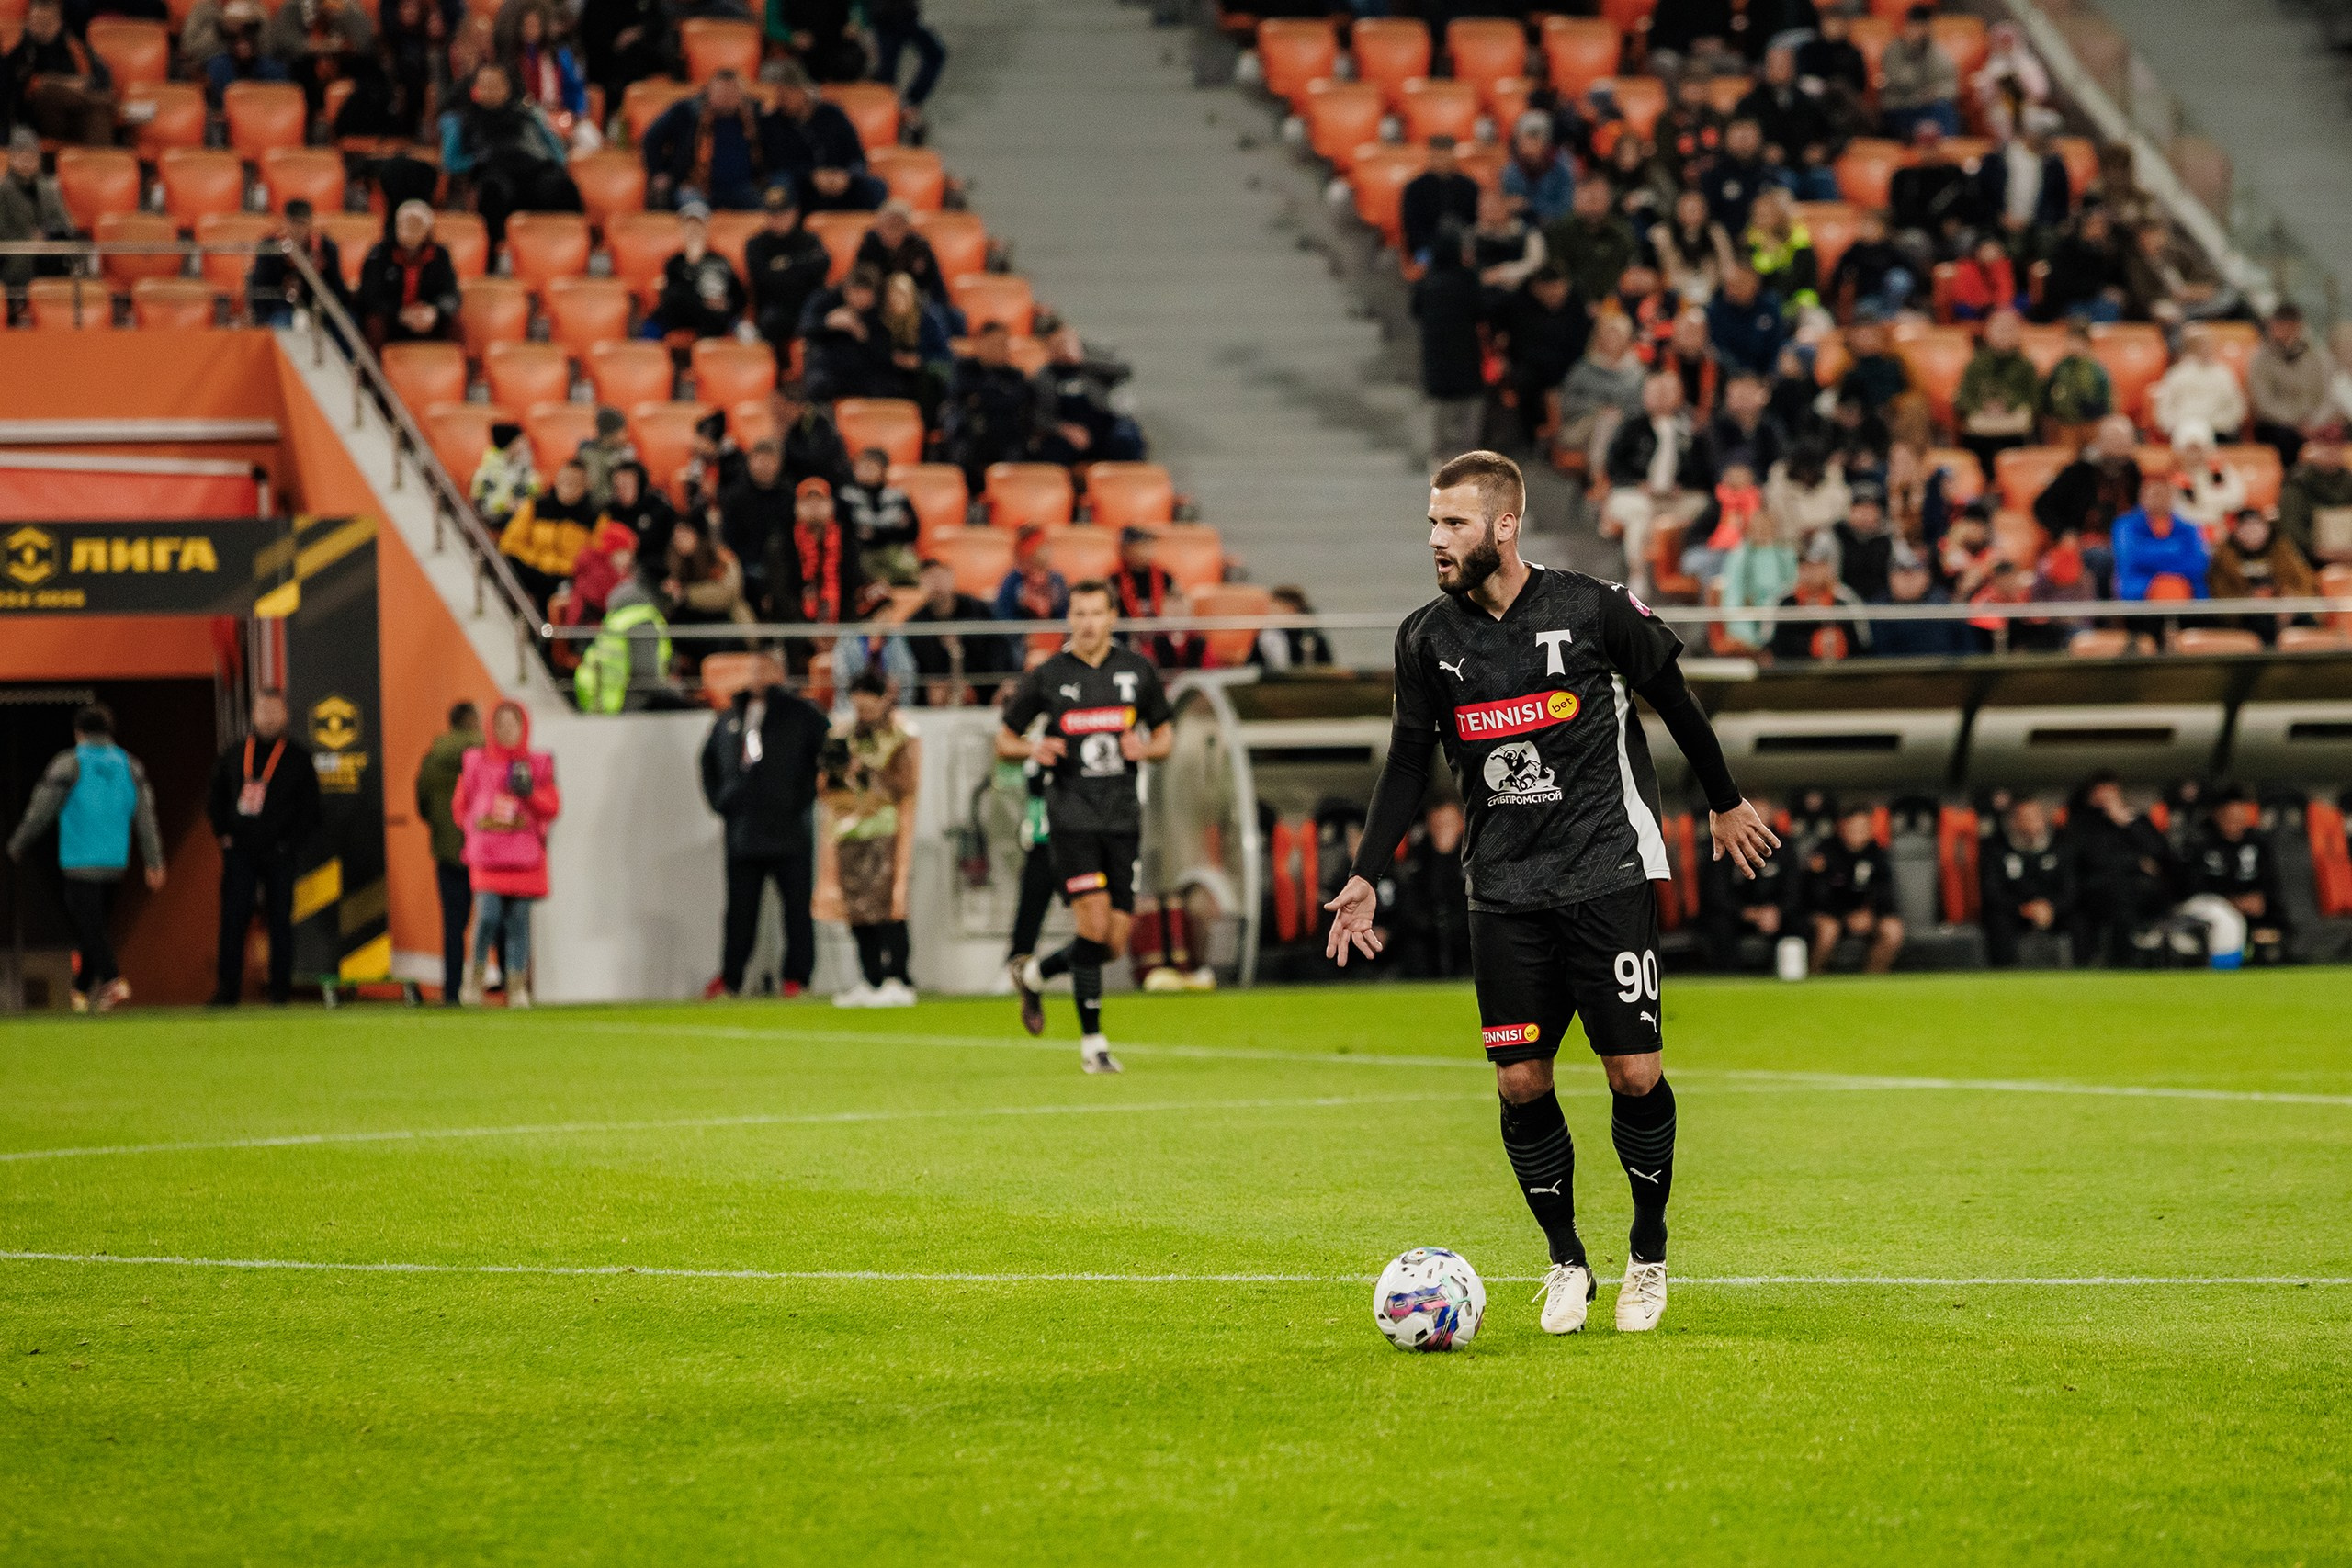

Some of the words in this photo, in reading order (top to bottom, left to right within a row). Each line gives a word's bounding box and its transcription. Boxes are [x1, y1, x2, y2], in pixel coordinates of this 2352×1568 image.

[70, 536, 219, 573] ЛИГА
[1457, 701, 1544, 733] TENNISI
[1551, 697, 1573, 714] bet
[1487, 790, 1563, 807] СИБПРОМСТРОЙ
[1614, 949, 1658, 1003] 90
